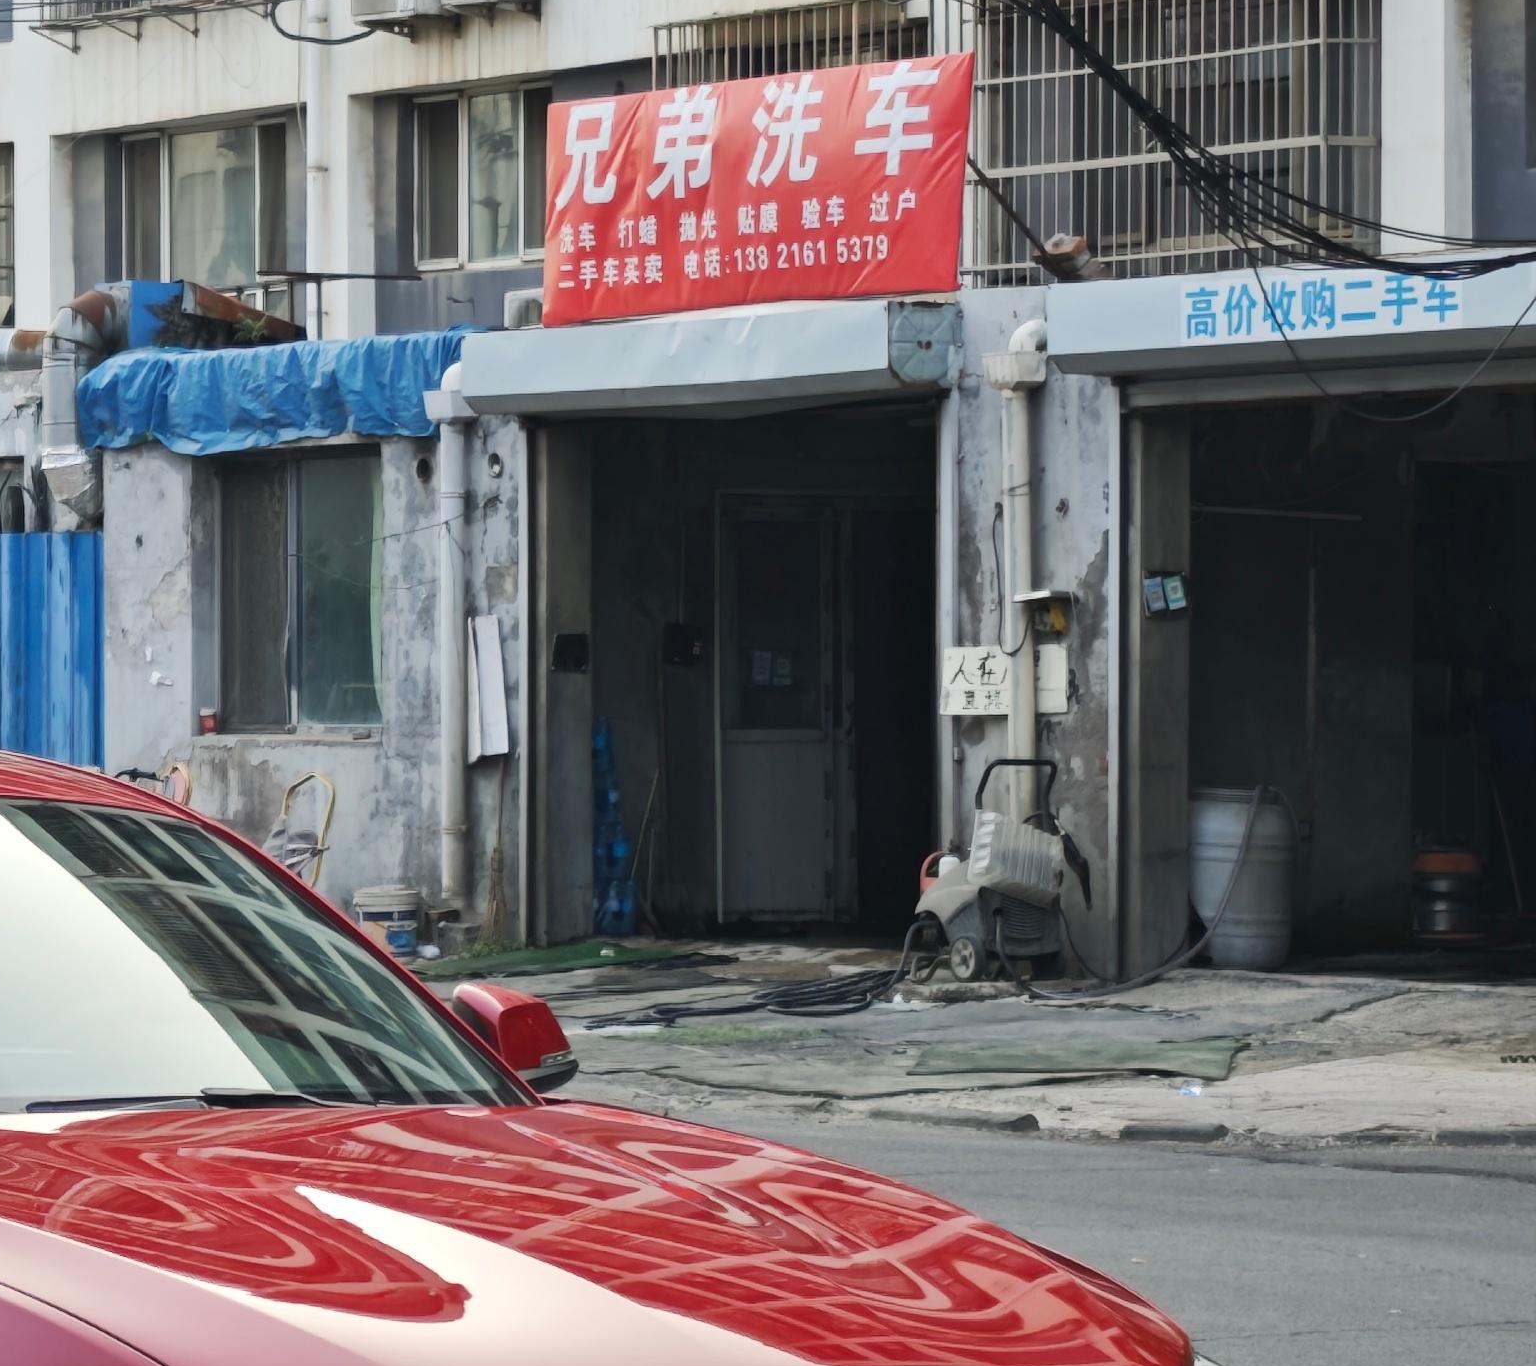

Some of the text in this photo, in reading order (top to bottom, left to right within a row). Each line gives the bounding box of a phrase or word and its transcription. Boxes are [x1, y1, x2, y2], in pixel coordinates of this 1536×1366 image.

[555, 61, 940, 209] 兄弟洗车
[559, 222, 596, 254] 洗车
[618, 215, 657, 248] 打蜡
[738, 202, 779, 235] 贴膜
[801, 195, 846, 230] 验车
[869, 188, 917, 223] 过户
[559, 254, 663, 291] 二手车买卖
[777, 241, 827, 269] 2161
[837, 235, 889, 265] 5379
[1185, 273, 1459, 340] 高价收购二手车
